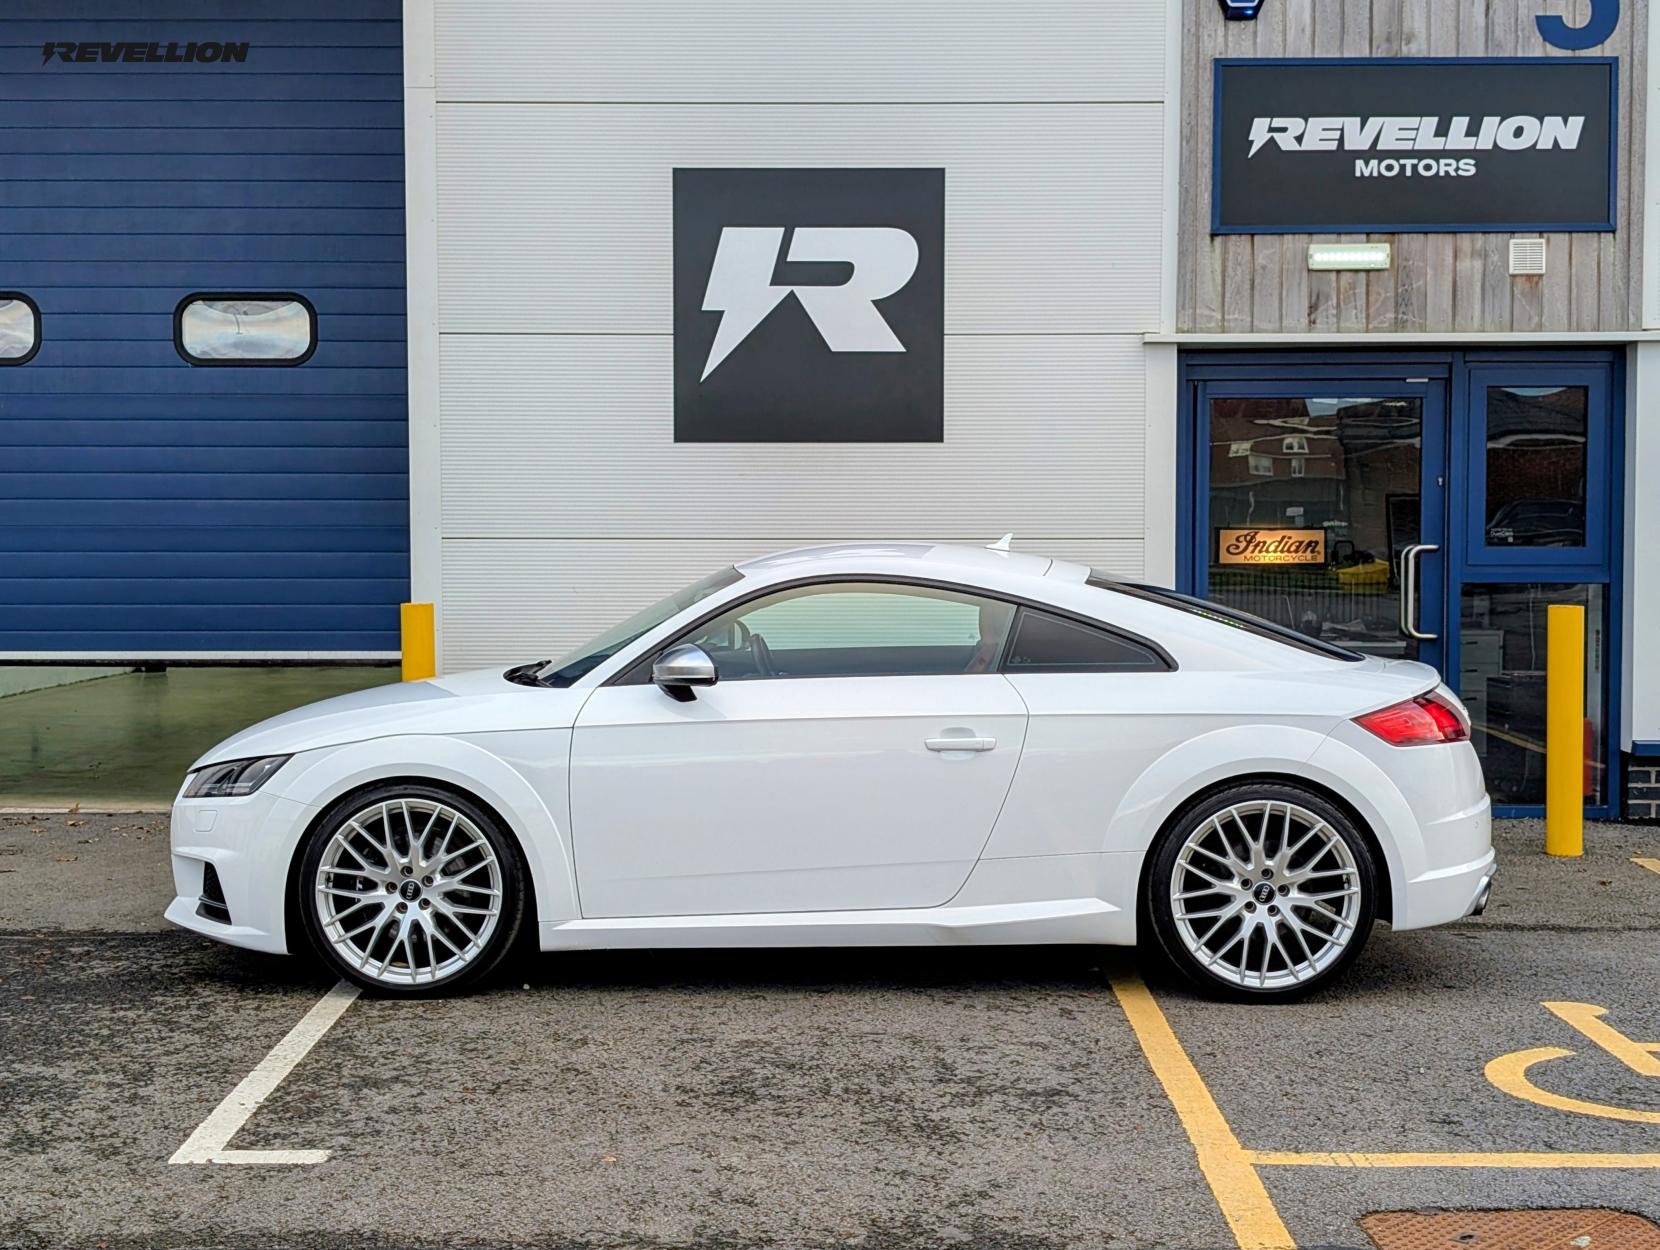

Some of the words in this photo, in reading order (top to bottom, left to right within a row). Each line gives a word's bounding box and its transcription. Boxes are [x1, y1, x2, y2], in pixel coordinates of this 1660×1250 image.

[1247, 116, 1585, 159] REVELLION
[1355, 158, 1477, 177] MOTORS
[1226, 531, 1320, 555] Indian
